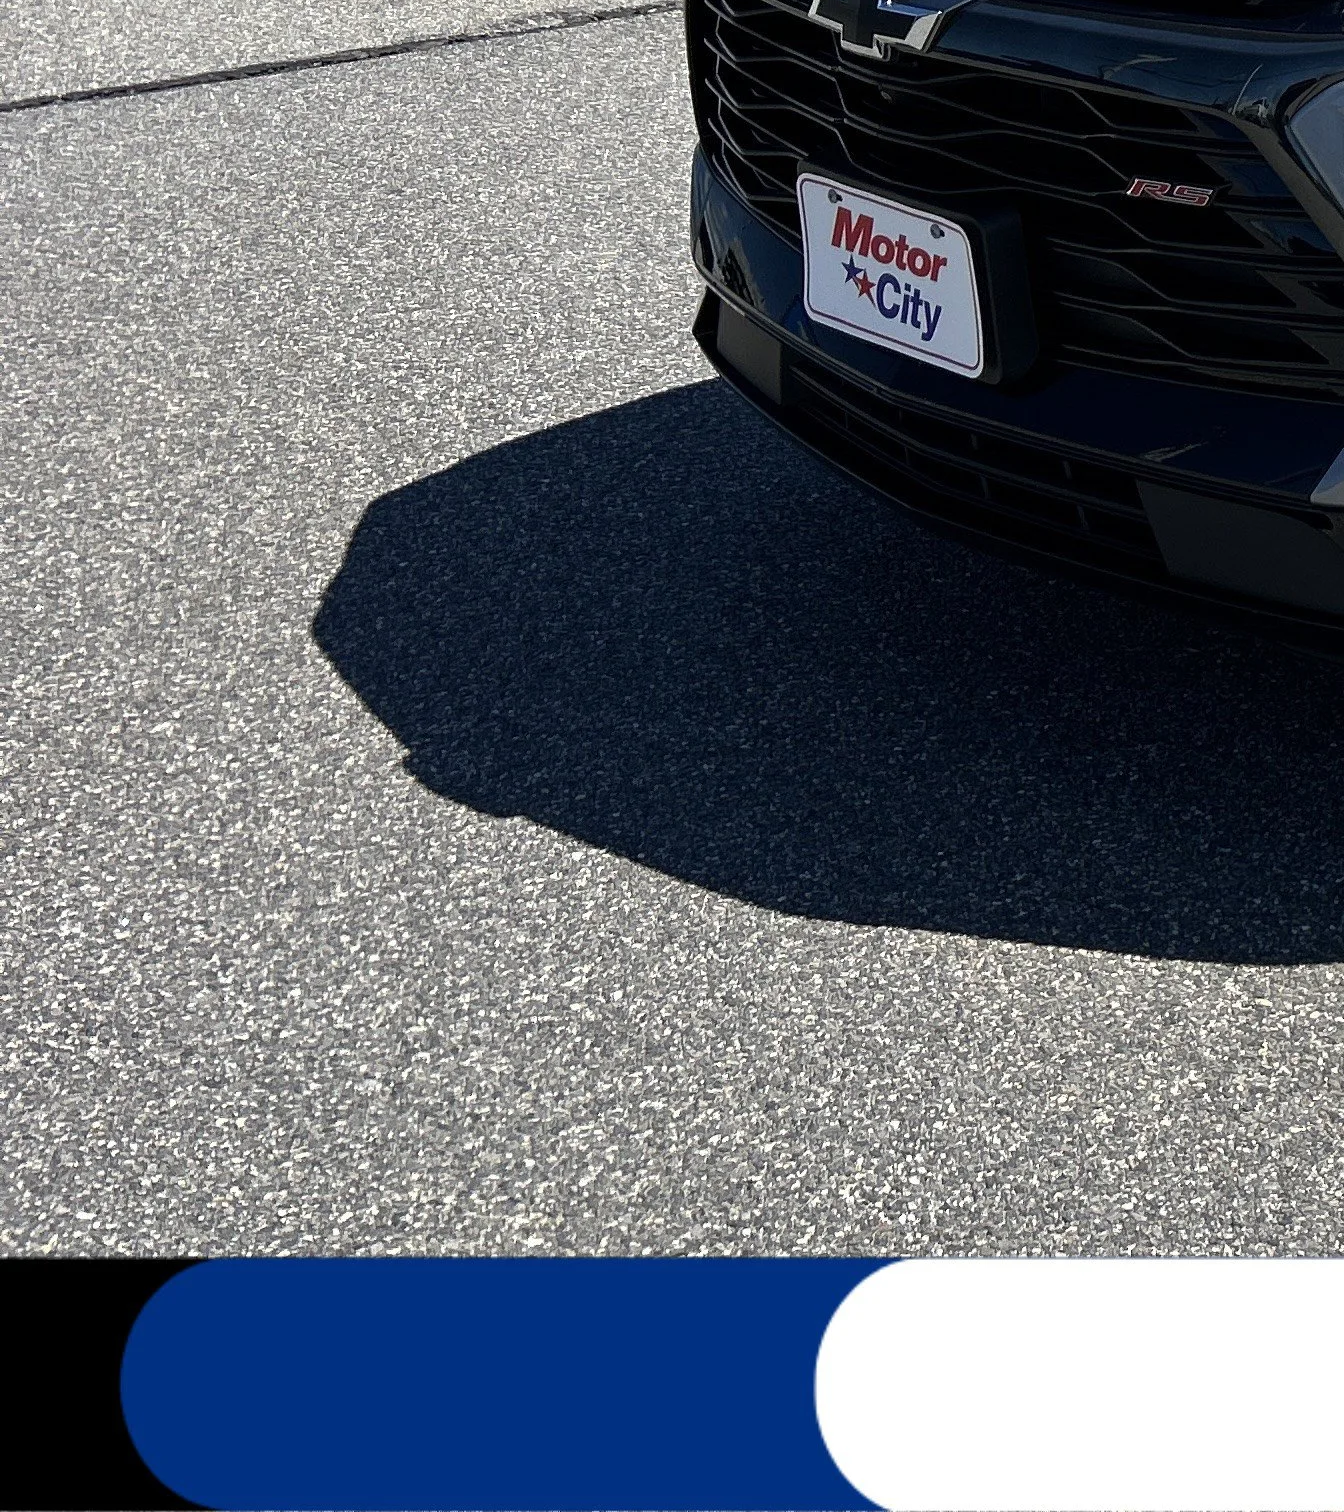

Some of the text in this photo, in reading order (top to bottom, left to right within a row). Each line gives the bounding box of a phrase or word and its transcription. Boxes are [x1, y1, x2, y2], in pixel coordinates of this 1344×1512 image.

[1126, 178, 1213, 206] RS
[831, 206, 947, 282] Motor
[876, 273, 942, 342] City
